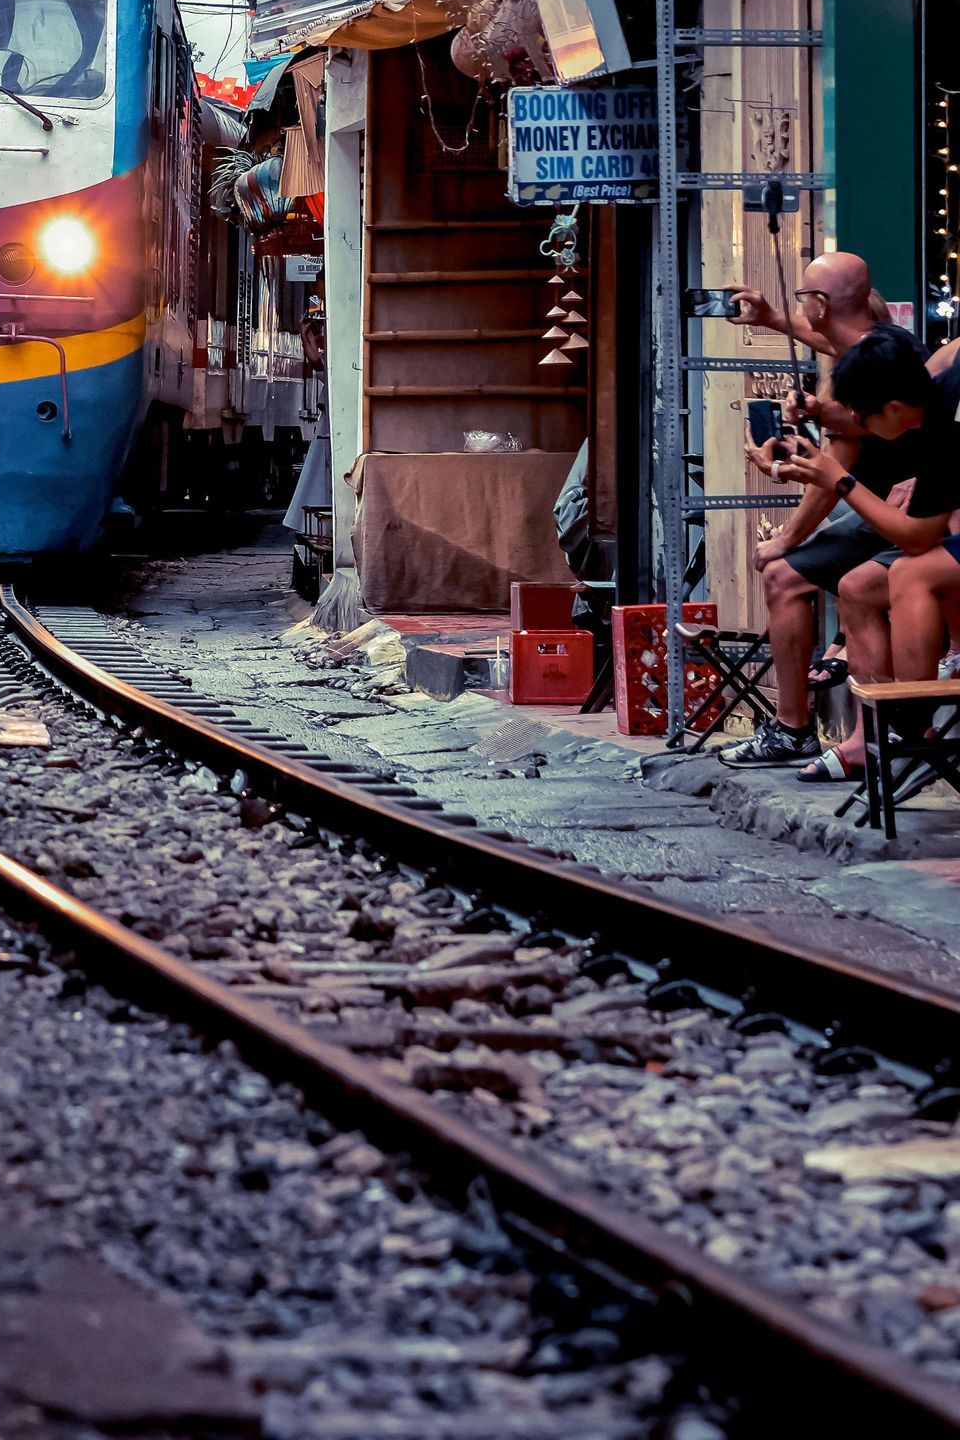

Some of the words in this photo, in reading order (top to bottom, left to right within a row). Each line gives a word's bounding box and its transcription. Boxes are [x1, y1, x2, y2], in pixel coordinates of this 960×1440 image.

[514, 93, 607, 121] BOOKING
[613, 92, 684, 120] OFFIE
[516, 126, 580, 152] MONEY
[587, 124, 685, 151] EXCHANE
[536, 155, 574, 180] SIM
[581, 155, 634, 178] CARD
[573, 185, 598, 198] (Best
[601, 184, 631, 198] Price)
